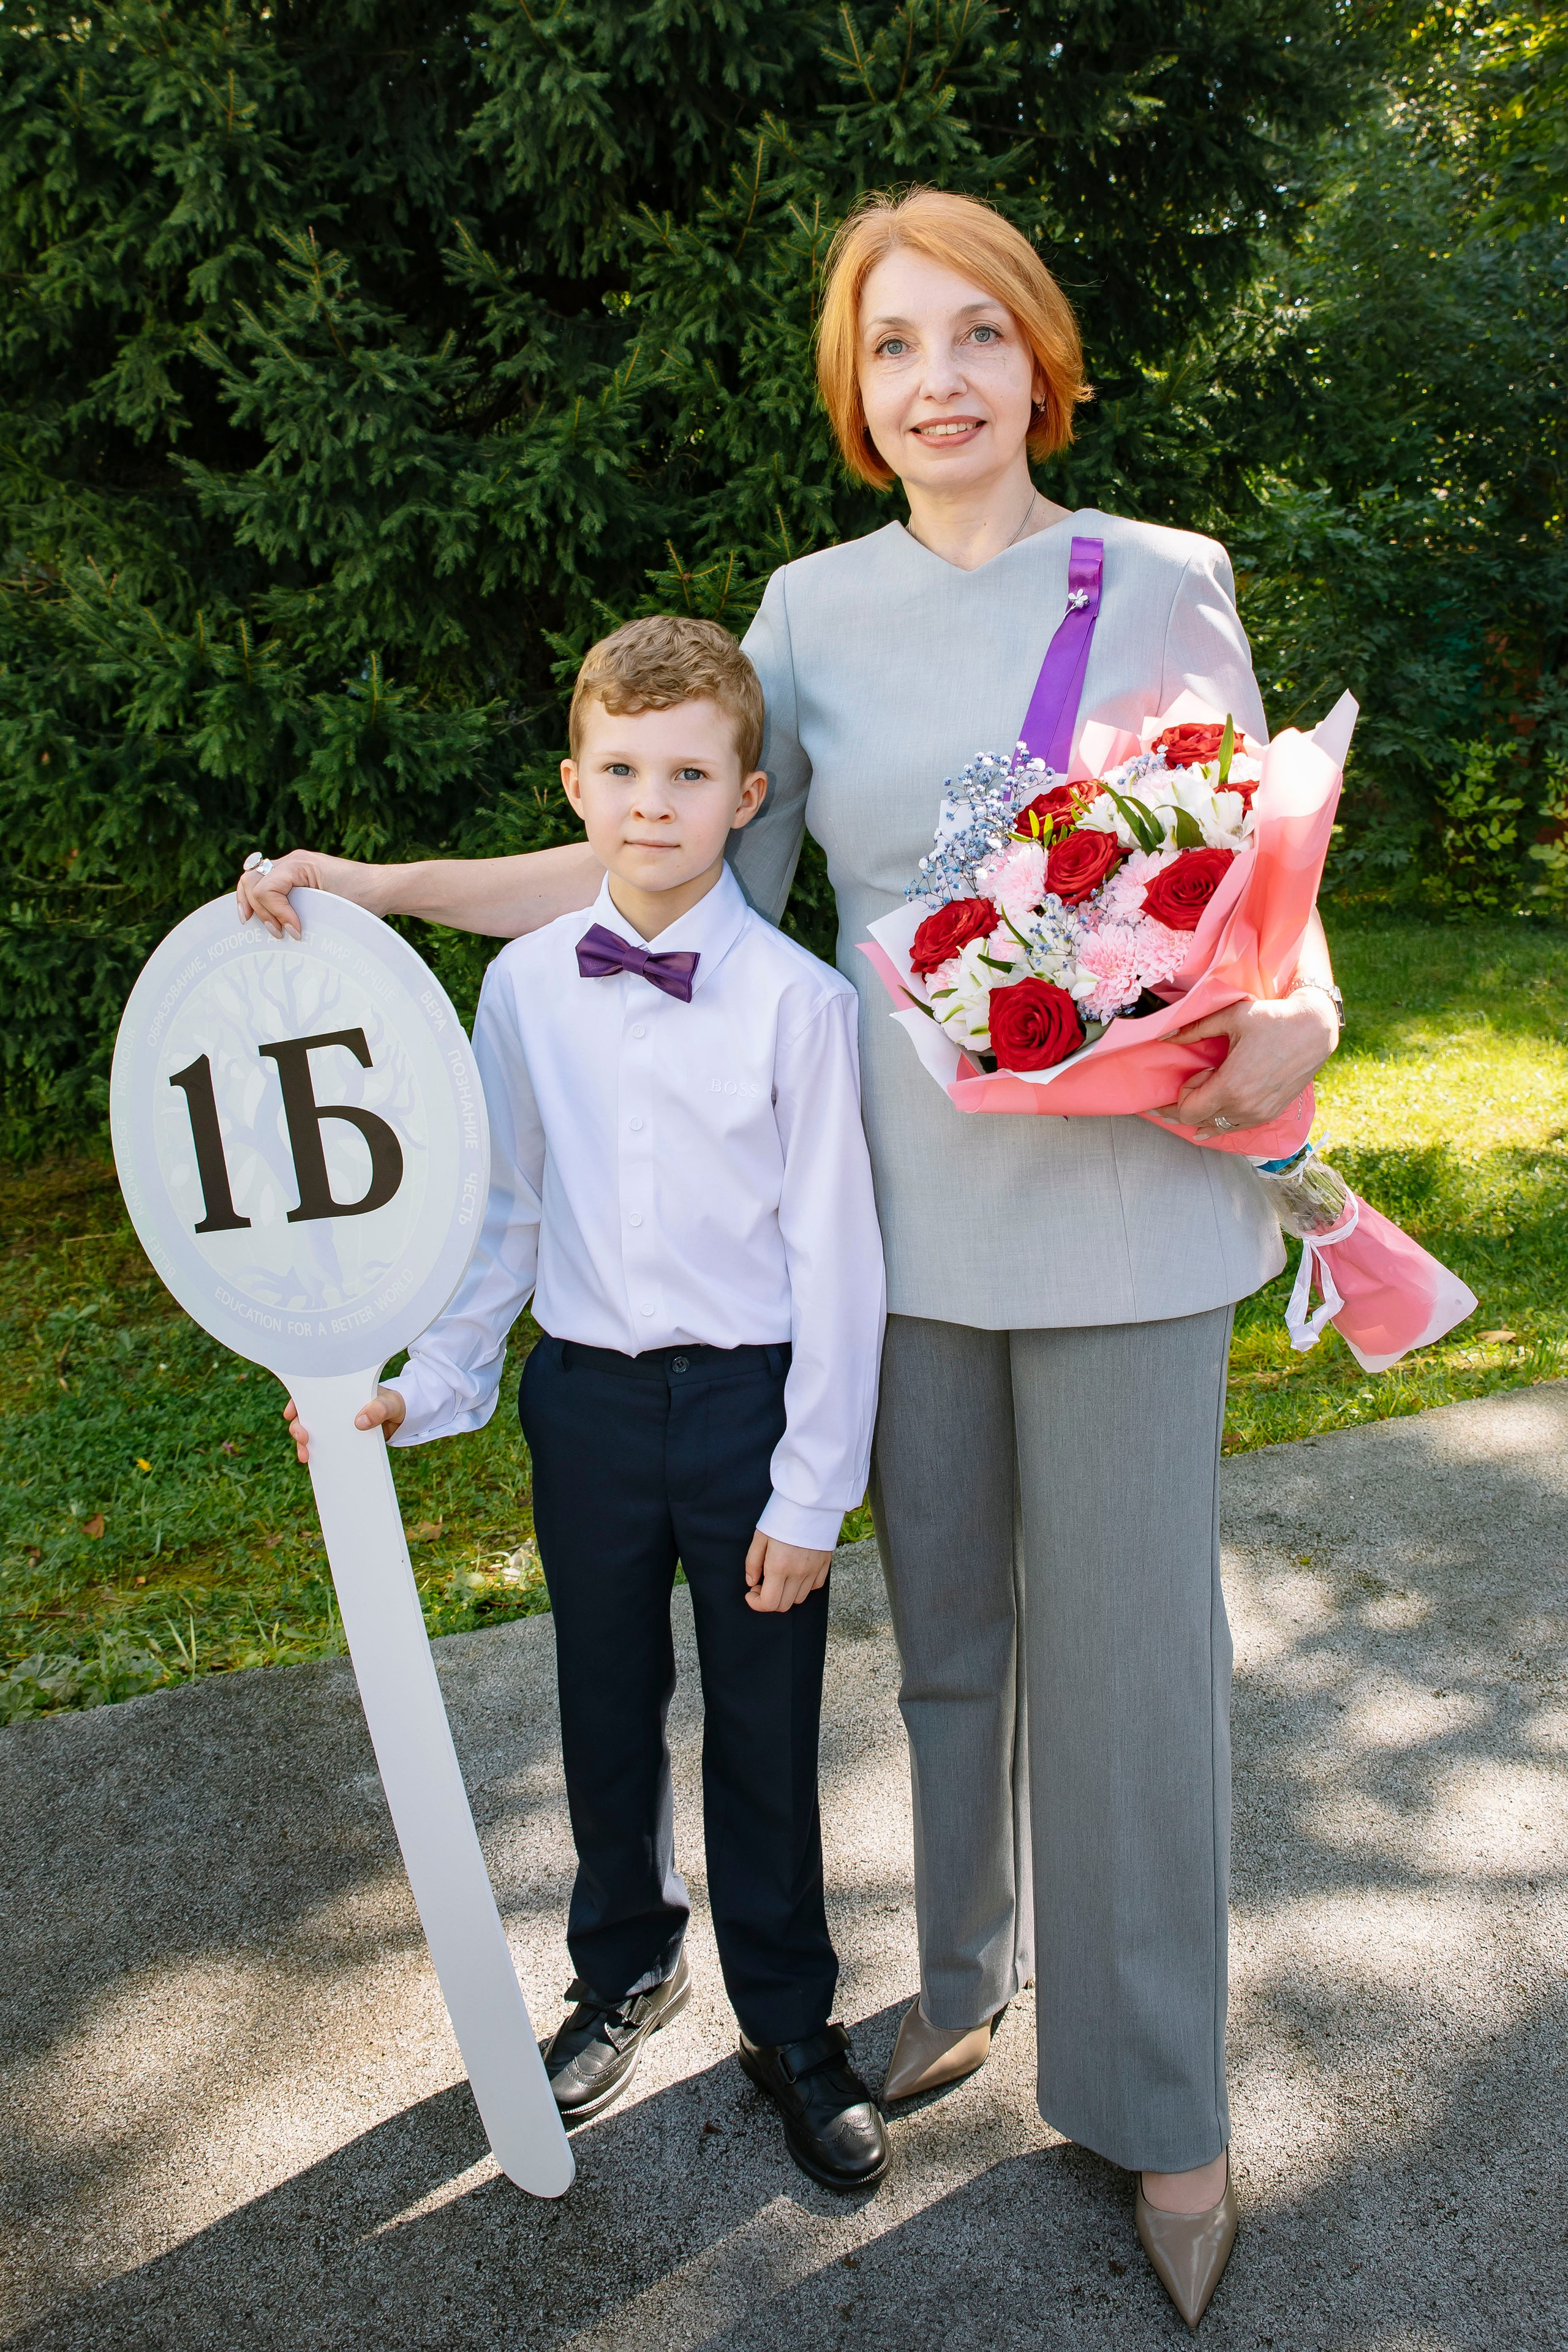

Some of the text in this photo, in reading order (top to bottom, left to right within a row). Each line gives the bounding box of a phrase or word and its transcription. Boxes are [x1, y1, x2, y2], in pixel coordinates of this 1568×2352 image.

[147, 956, 206, 1047] ОБРАЗОВАНИЕ,
[207, 929, 262, 961] КОТОРОЕ
[321, 937, 350, 960] МИР
[353, 959, 396, 1004] ЛУЧШЕ
[116, 1027, 176, 1279] BELIEF KNOWLEDGE HONOUR
[169, 1027, 403, 1234] 1Б
[420, 990, 478, 1225] ВЕРА ПОЗНАНИЕ ЧЕСТЬ
[709, 1078, 759, 1099] BOSS
[215, 1268, 414, 1336] EDUCATION FOR A BETTER WORLD
